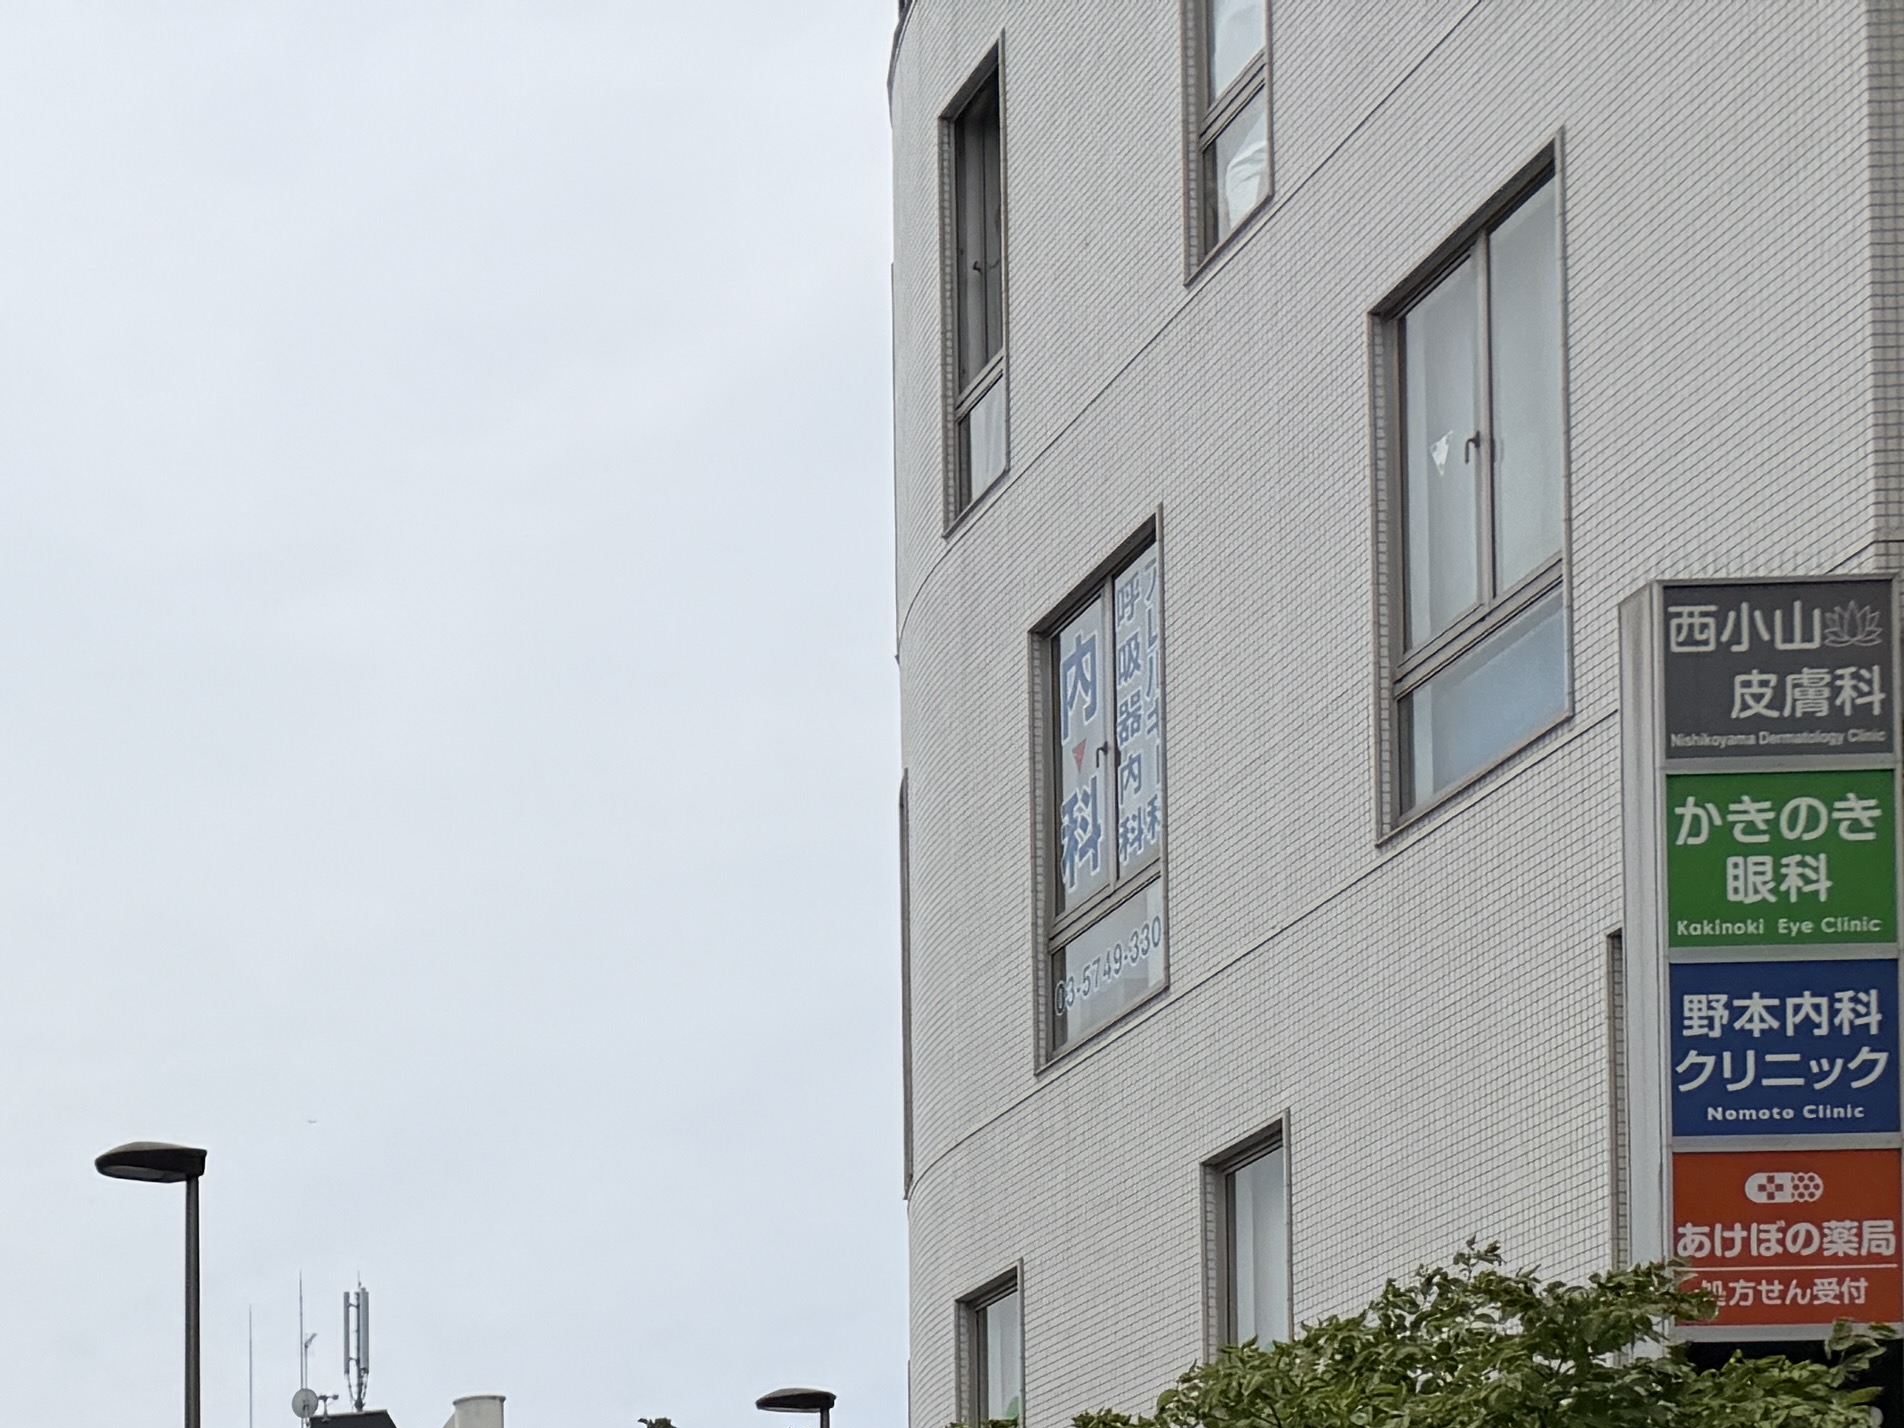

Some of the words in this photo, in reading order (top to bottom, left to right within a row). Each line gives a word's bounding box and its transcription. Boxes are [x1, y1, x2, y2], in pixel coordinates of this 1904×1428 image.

[1668, 600, 1822, 653] 西小山
[1730, 665, 1886, 719] 皮膚科
[1117, 571, 1142, 864] 呼吸器内科
[1670, 732, 1755, 750] Nishikoyama
[1758, 730, 1844, 746] Dermatology
[1847, 728, 1886, 743] Clinic
[1674, 793, 1882, 845] かきのき
[1726, 853, 1832, 904] 眼科
[1677, 918, 1764, 936] Kakinoki
[1778, 917, 1813, 937] Eye
[1821, 916, 1882, 934] Clinic
[1682, 989, 1882, 1038] 野本内科
[1675, 1046, 1889, 1092] クリニック
[1707, 1106, 1794, 1121] Nomoto
[1803, 1104, 1864, 1120] Clinic
[1677, 1219, 1896, 1258] あけぼの薬局
[1701, 1277, 1868, 1306] 処方せん受付
